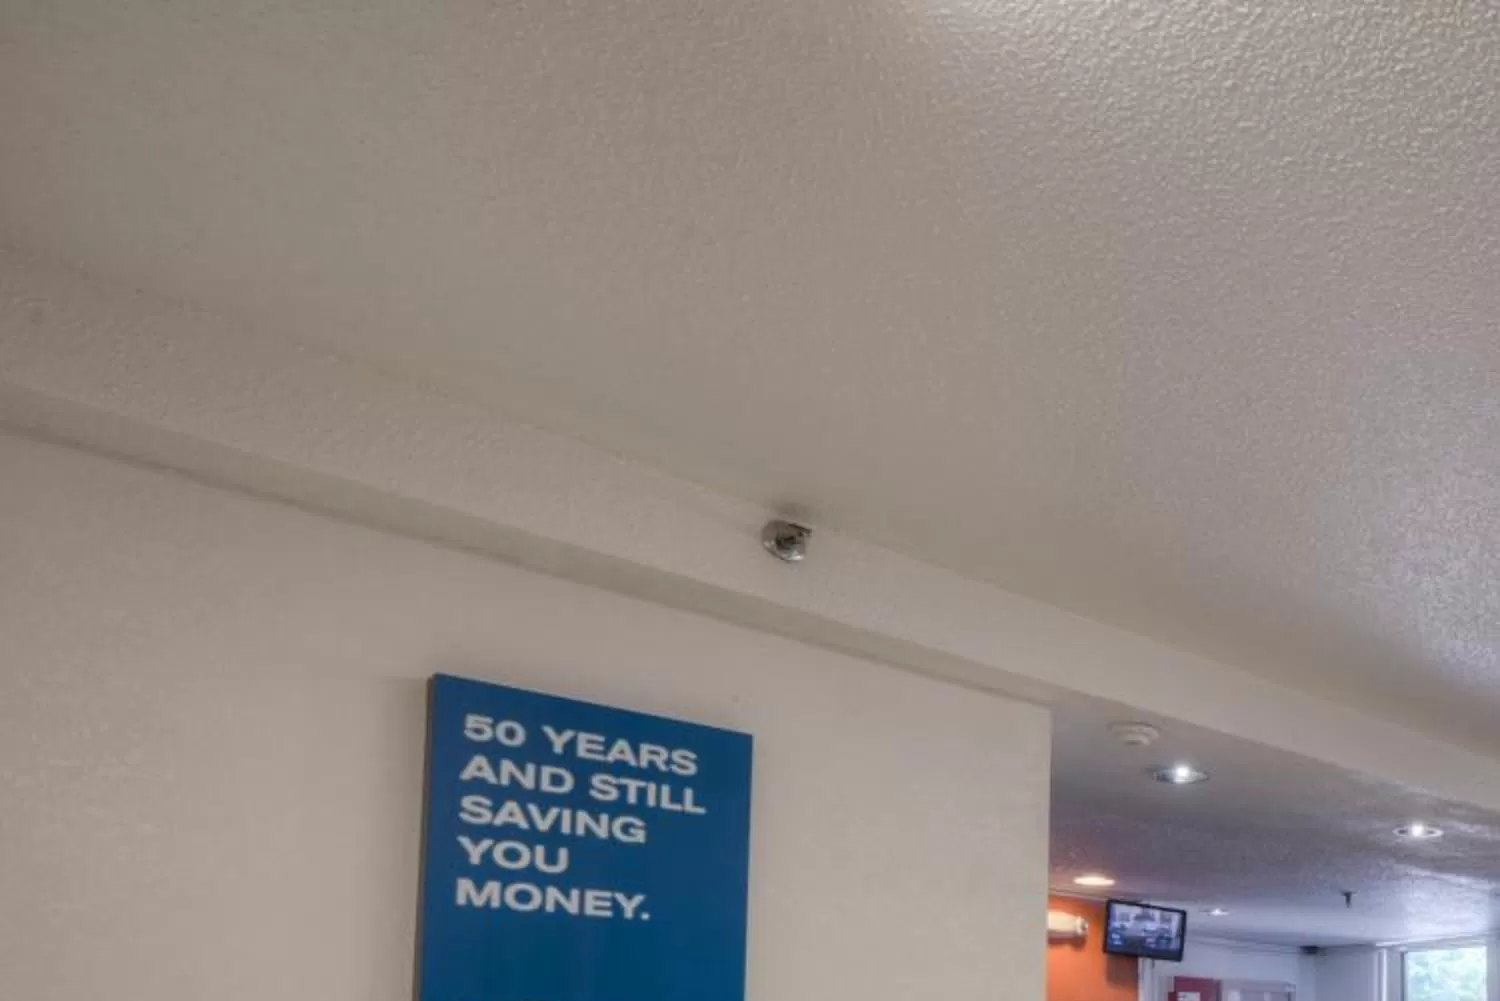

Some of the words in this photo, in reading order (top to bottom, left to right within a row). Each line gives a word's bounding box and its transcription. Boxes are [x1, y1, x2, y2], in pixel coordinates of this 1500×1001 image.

[463, 713, 526, 747] 50
[541, 725, 698, 776] YEARS
[459, 756, 574, 795] AND
[588, 774, 707, 814] STILL
[458, 796, 647, 843] SAVING
[456, 836, 570, 874] YOU
[455, 878, 651, 921] MONEY.
